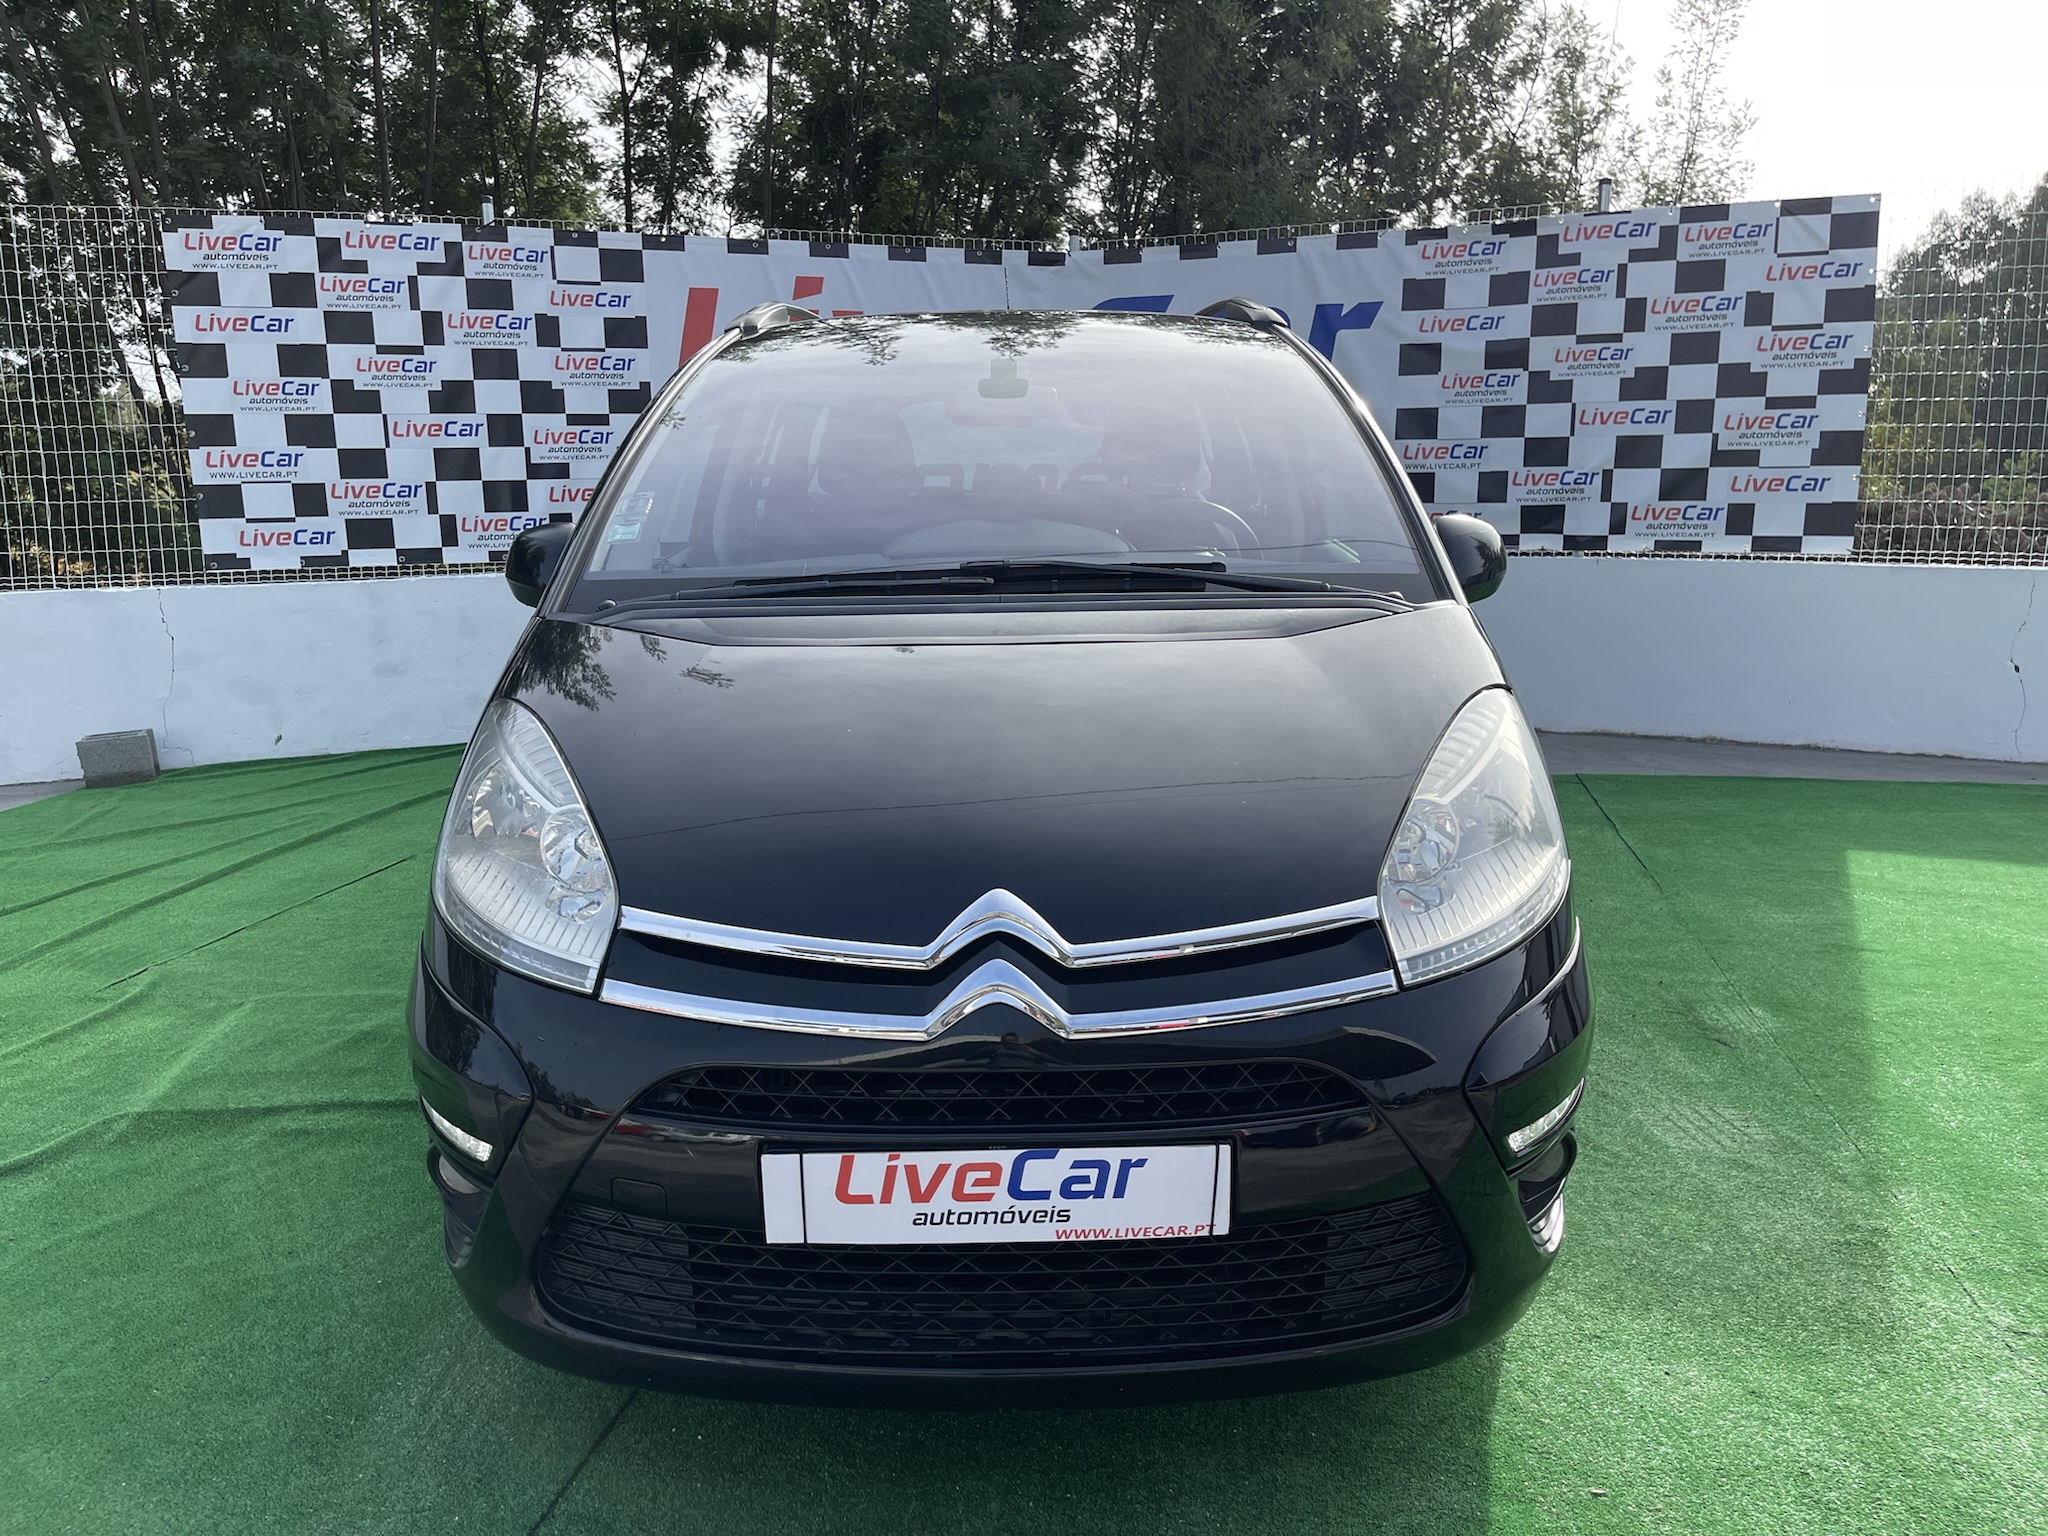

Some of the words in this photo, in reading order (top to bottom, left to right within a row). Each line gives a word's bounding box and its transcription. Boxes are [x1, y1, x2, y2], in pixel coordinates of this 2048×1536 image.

[1562, 221, 1656, 243] LiveCar
[1684, 220, 1773, 242] LiveCar
[184, 233, 282, 251] LiveCar
[344, 231, 440, 251] LiveCar
[1699, 240, 1758, 250] automóveis
[203, 252, 269, 261] automóveis
[468, 244, 548, 263] LiveCar
[1421, 241, 1506, 259] LiveCar
[1688, 249, 1765, 258] WWW.LIVECAR.PT
[483, 263, 537, 271] automóveis
[1435, 257, 1492, 268] automóveis
[1425, 267, 1499, 276] WWW.LIVECAR.PT
[1533, 269, 1615, 287] LiveCar
[1765, 262, 1863, 282] LiveCar
[320, 276, 405, 293] LiveCar
[1546, 284, 1601, 295] automóveis
[336, 294, 394, 302] automóveis
[550, 290, 631, 308] LiveCar
[1537, 294, 1607, 302] WWW.LIVECAR.PT
[1650, 296, 1743, 314] LiveCar
[195, 314, 294, 332] LiveCar
[448, 313, 532, 330] LiveCar
[1419, 315, 1505, 333] LiveCar
[1654, 323, 1735, 331] WWW.LIVECAR.PT
[1665, 315, 1727, 323] automóveis
[463, 330, 520, 338] automóveis
[1757, 333, 1853, 351] LiveCar
[555, 355, 635, 370] LiveCar
[1555, 347, 1633, 362] LiveCar
[1772, 351, 1836, 360] automóveis
[356, 358, 437, 373] LiveCar
[1567, 362, 1620, 370] automóveis
[233, 379, 319, 396] LiveCar
[1441, 373, 1520, 389] LiveCar
[1454, 389, 1507, 397] automóveis
[1579, 408, 1672, 425] LiveCar
[1724, 413, 1819, 430] LiveCar
[393, 420, 484, 437] LiveCar
[1739, 431, 1802, 439] automóveis
[534, 429, 613, 445] LiveCar
[206, 450, 304, 468] LiveCar
[1403, 443, 1488, 460] LiveCar
[1511, 470, 1600, 486] LiveCar
[1730, 475, 1831, 492] LiveCar
[331, 481, 423, 499] LiveCar
[1526, 487, 1585, 495] automóveis
[348, 500, 410, 508] automóveis
[1631, 505, 1724, 521] LiveCar
[239, 529, 336, 546] LiveCar
[834, 1150, 1148, 1205] LiveCar
[913, 1205, 1071, 1226] automóveis
[1056, 1224, 1215, 1239] WWW.LIVECAR.PT
